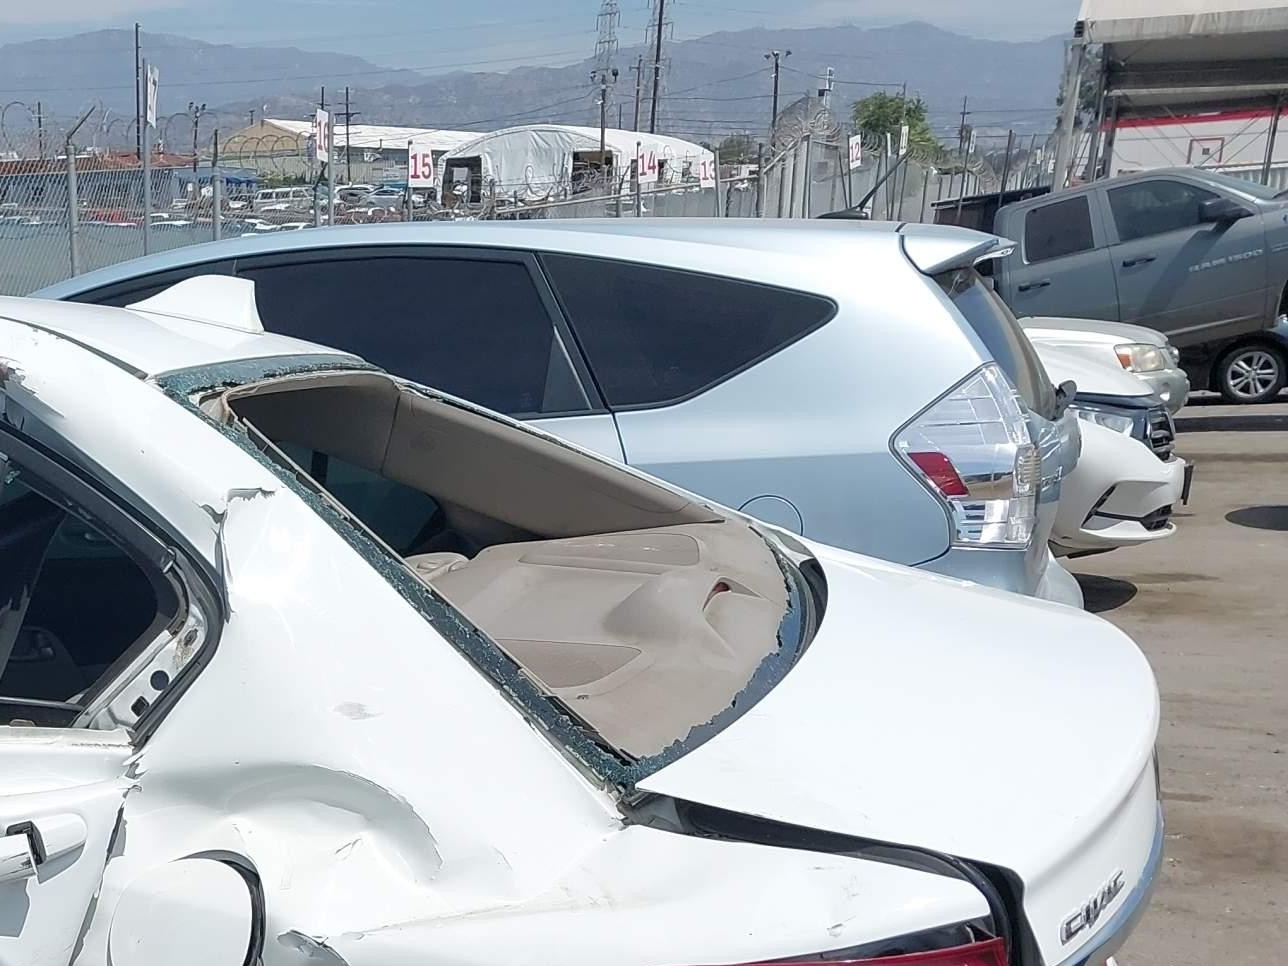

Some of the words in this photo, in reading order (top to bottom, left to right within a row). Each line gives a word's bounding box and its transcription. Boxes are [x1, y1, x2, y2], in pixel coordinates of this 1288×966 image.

[850, 142, 860, 163] 12
[410, 152, 432, 179] 15
[639, 151, 657, 177] 14
[700, 159, 715, 180] 13
[1188, 257, 1226, 273] RAM
